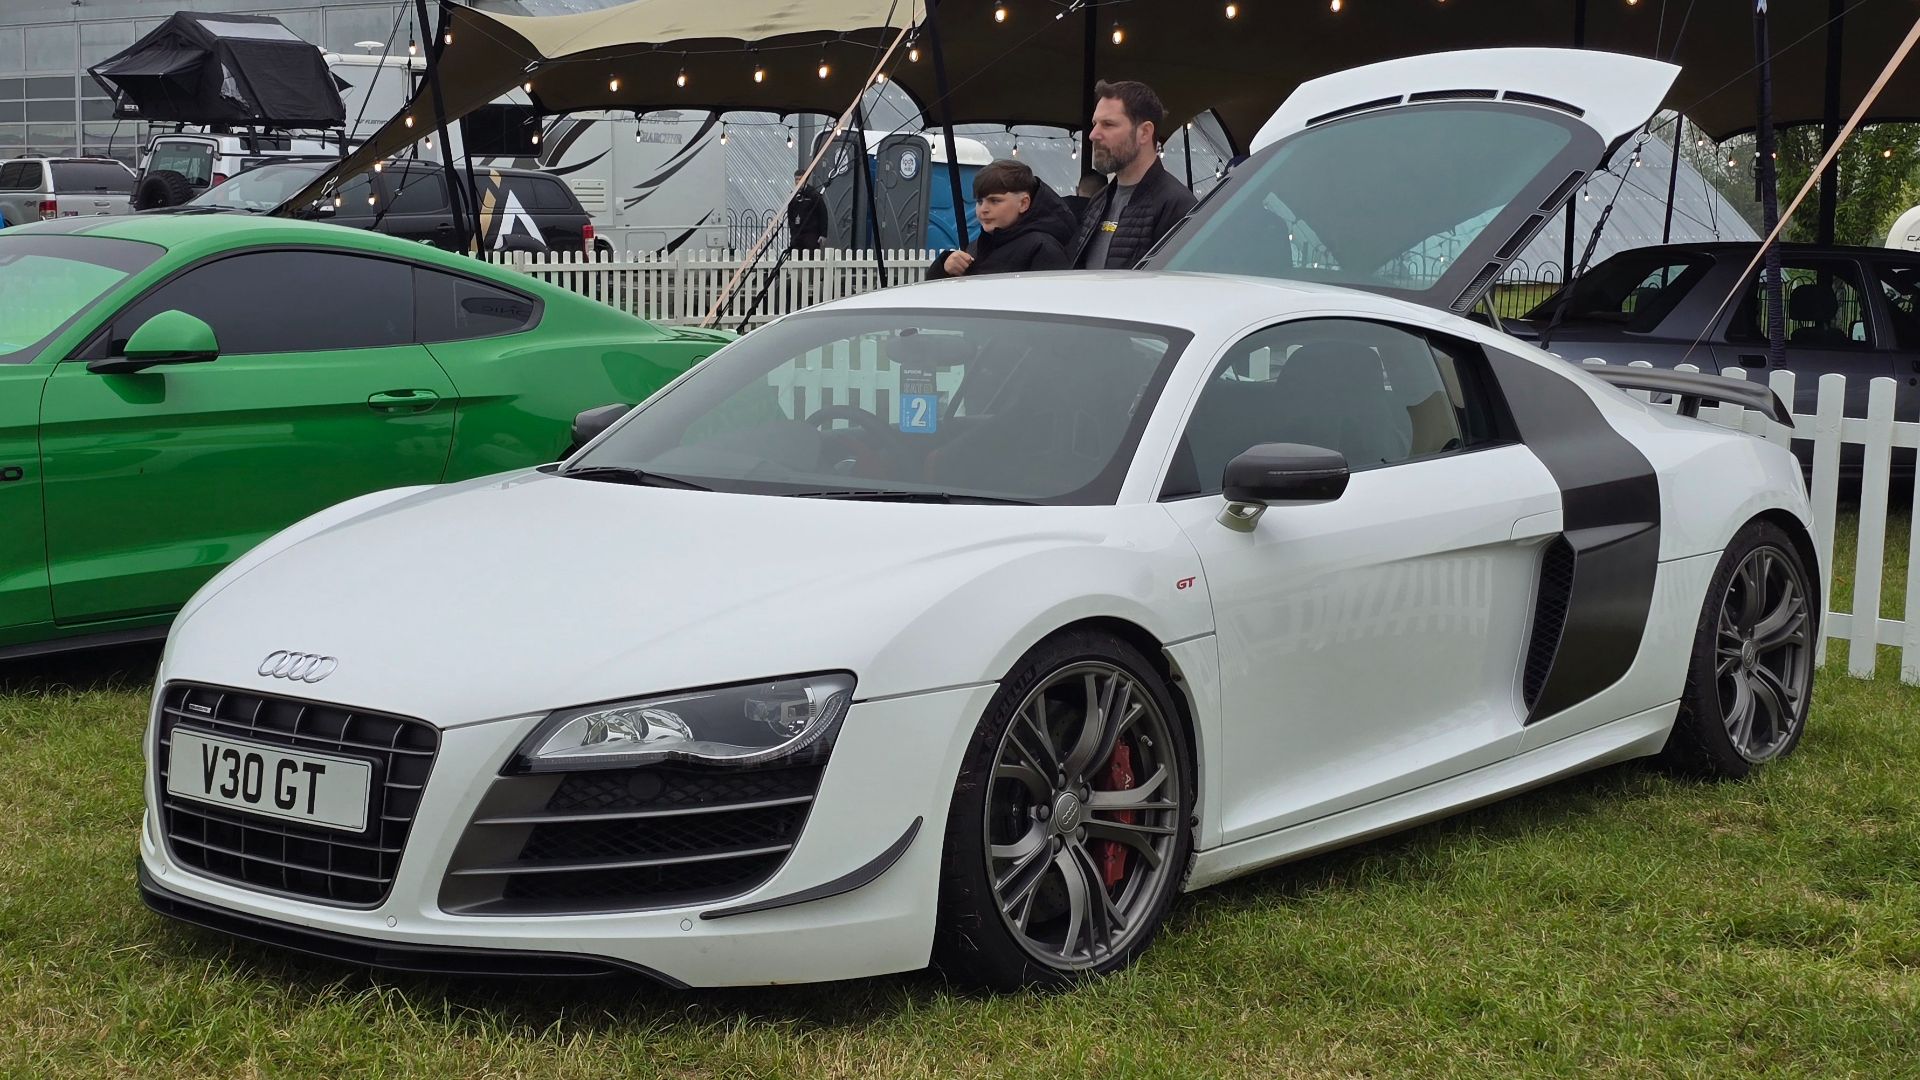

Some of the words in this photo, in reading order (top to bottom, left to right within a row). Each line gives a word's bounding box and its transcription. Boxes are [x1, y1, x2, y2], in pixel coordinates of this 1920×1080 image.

[911, 397, 927, 427] 2
[1176, 576, 1196, 590] GT
[202, 743, 264, 804] V30
[274, 758, 326, 815] GT
